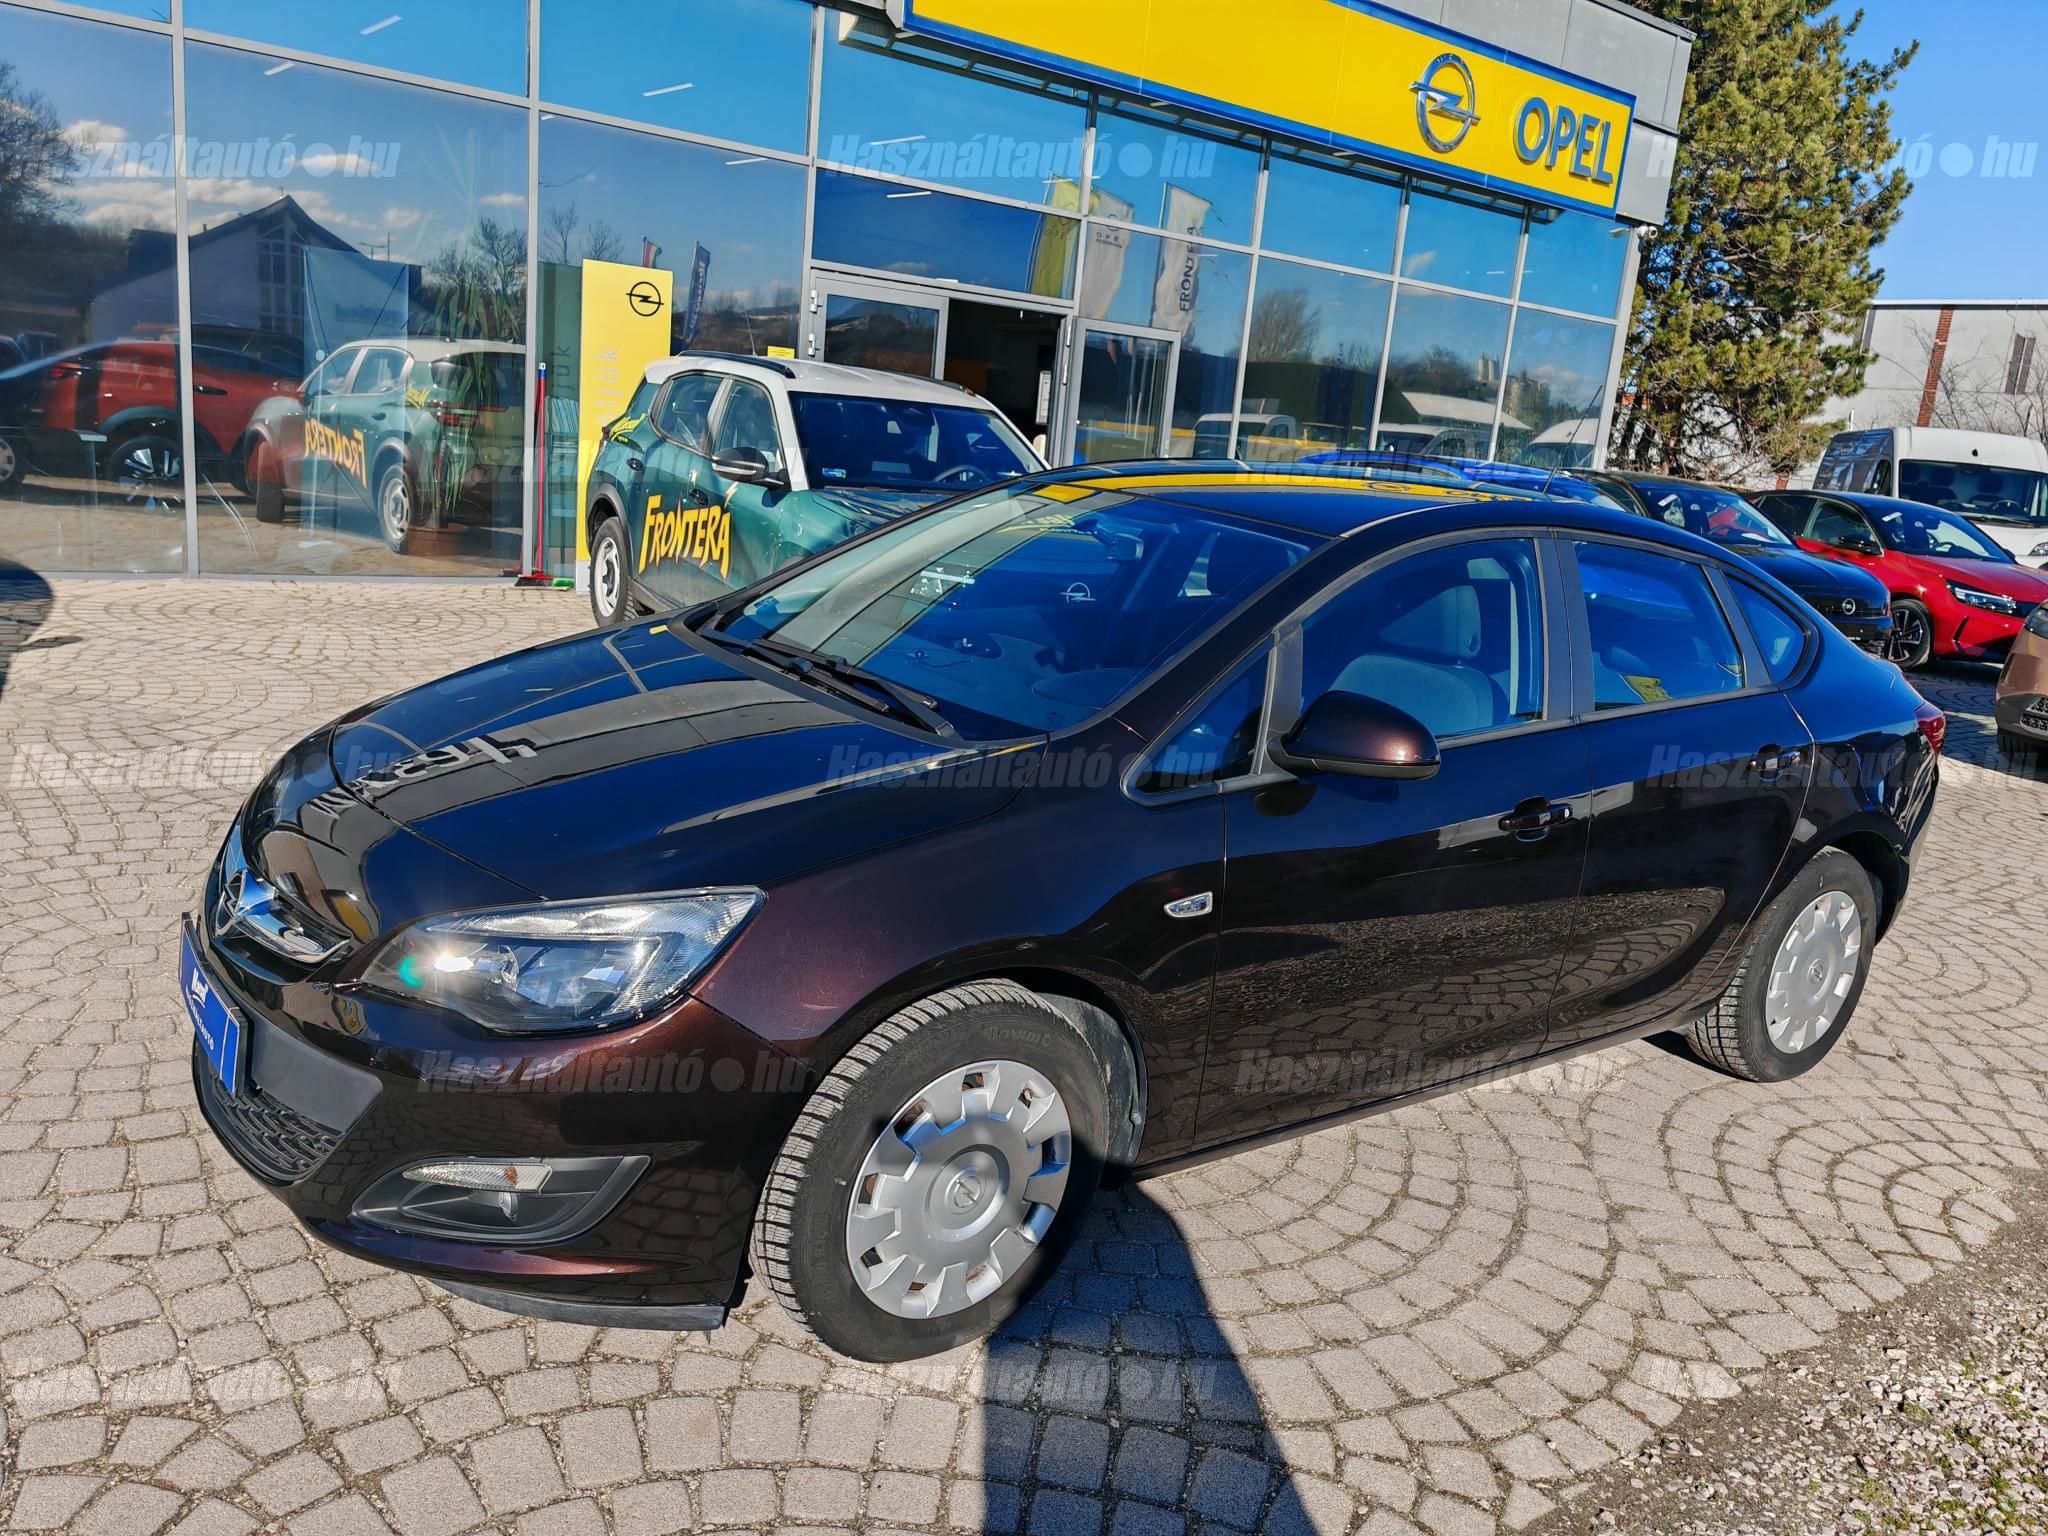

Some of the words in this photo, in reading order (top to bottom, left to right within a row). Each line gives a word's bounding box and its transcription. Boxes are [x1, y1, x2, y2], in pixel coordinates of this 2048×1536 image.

[1513, 96, 1614, 186] OPEL
[1179, 225, 1197, 313] FRONTEA
[638, 494, 731, 580] FRONTERA
